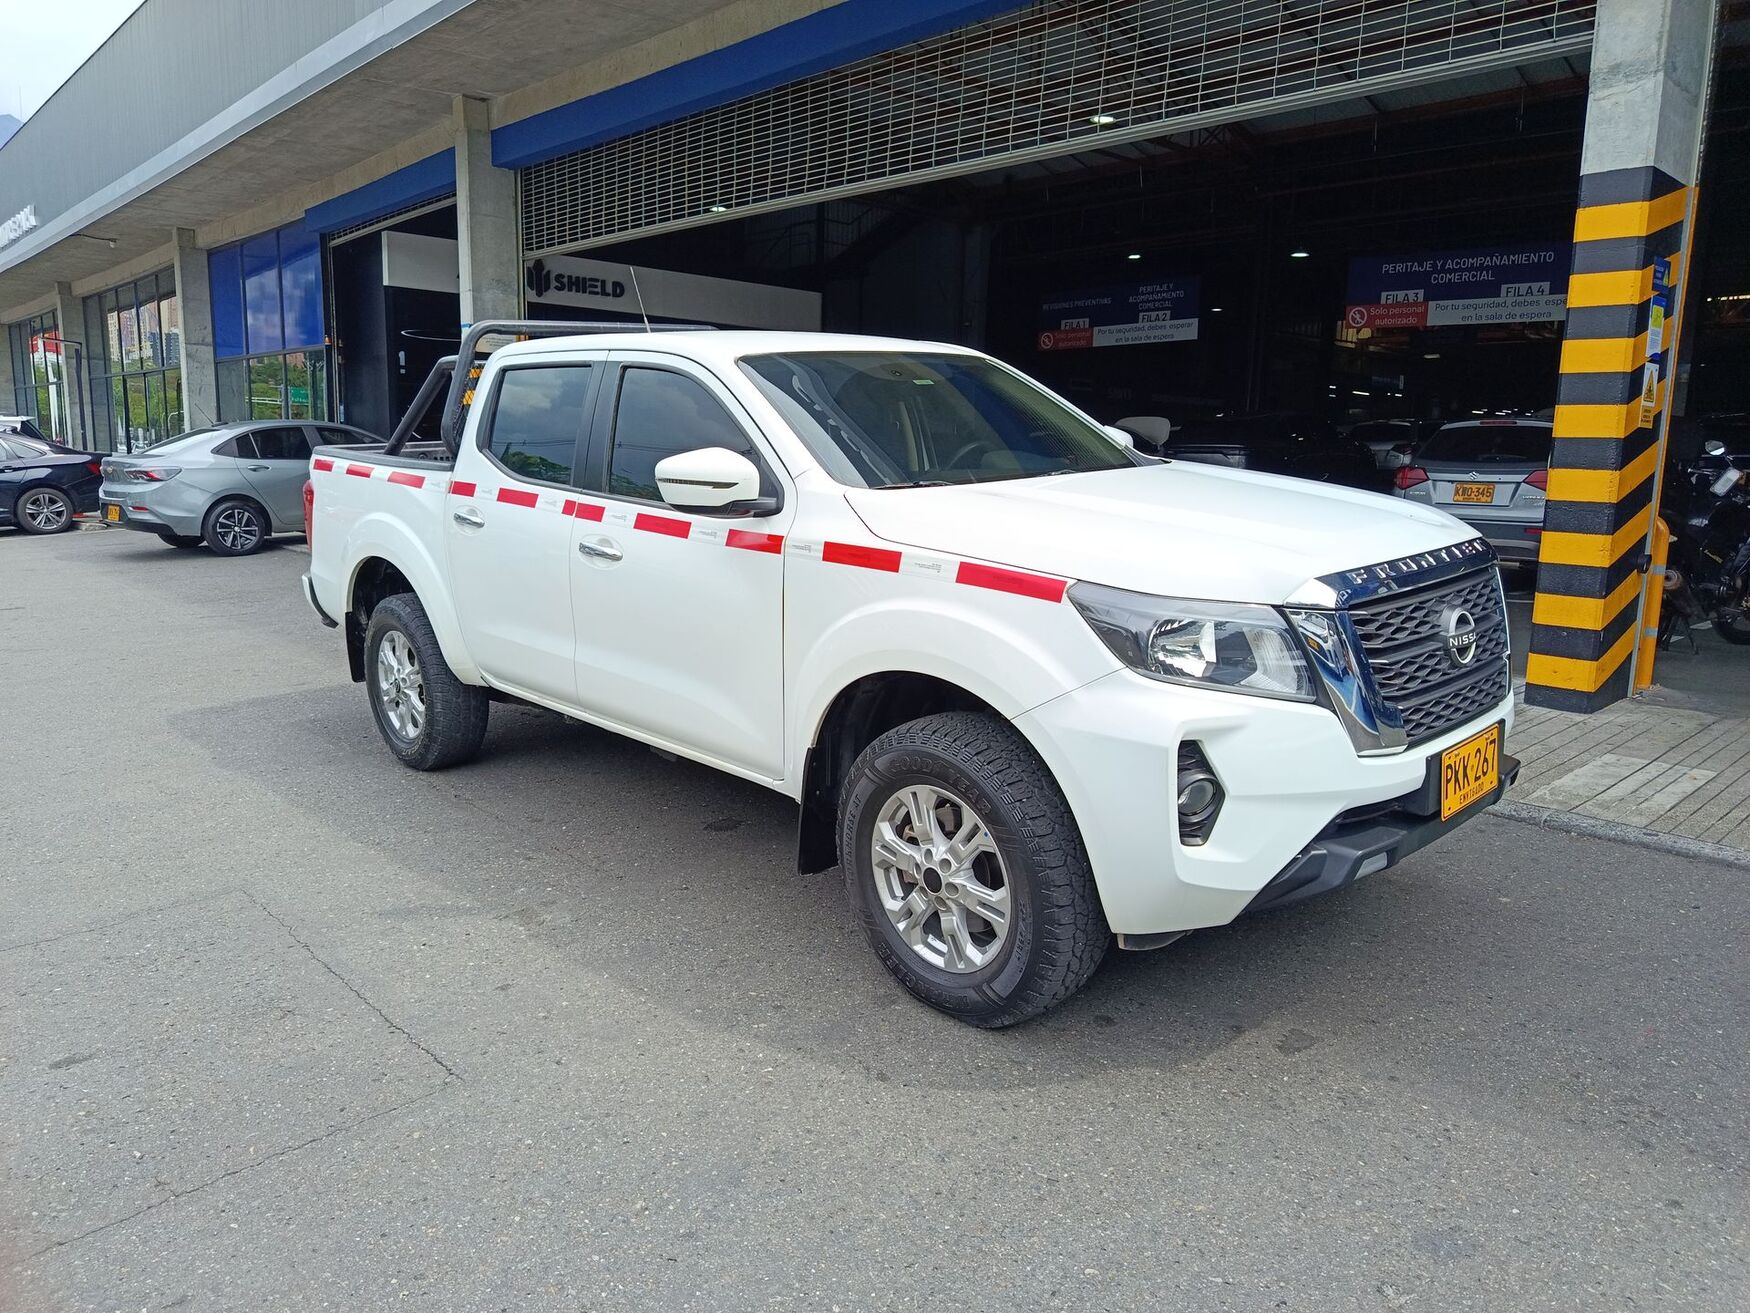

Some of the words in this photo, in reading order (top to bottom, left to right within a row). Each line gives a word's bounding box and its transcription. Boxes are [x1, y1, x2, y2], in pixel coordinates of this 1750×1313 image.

[1382, 260, 1434, 274] PERITAJE
[1435, 260, 1444, 270] Y
[1445, 251, 1555, 270] ACOMPAÑAMIENTO
[1431, 270, 1496, 285] COMERCIAL
[553, 273, 625, 298] SHIELD
[1138, 284, 1168, 294] PERITAJE
[1505, 286, 1533, 297] FILA
[1536, 285, 1545, 296] 4
[1074, 298, 1112, 308] PREVENTIVAS
[1385, 293, 1410, 304] FILA
[1412, 292, 1419, 302] 3
[1138, 301, 1173, 310] COMERCIAL
[1435, 303, 1449, 312] Por
[1450, 303, 1459, 311] tu
[1460, 299, 1509, 312] seguridad,
[1511, 298, 1541, 308] debes
[1544, 298, 1568, 309] espe
[1141, 313, 1160, 323] FILA
[1161, 312, 1168, 322] 2
[1369, 307, 1388, 316] Solo
[1389, 305, 1425, 318] personal
[1461, 314, 1473, 322] en
[1475, 312, 1483, 321] la
[1484, 311, 1503, 321] sala
[1505, 311, 1518, 320] de
[1519, 311, 1552, 323] espera
[1064, 320, 1081, 329] FILA
[1375, 316, 1418, 325] autorizado
[1097, 328, 1108, 336] Por
[1147, 323, 1166, 331] debes
[1169, 321, 1194, 331] esperar
[1152, 333, 1175, 343] espera
[1450, 632, 1476, 647] NISS
